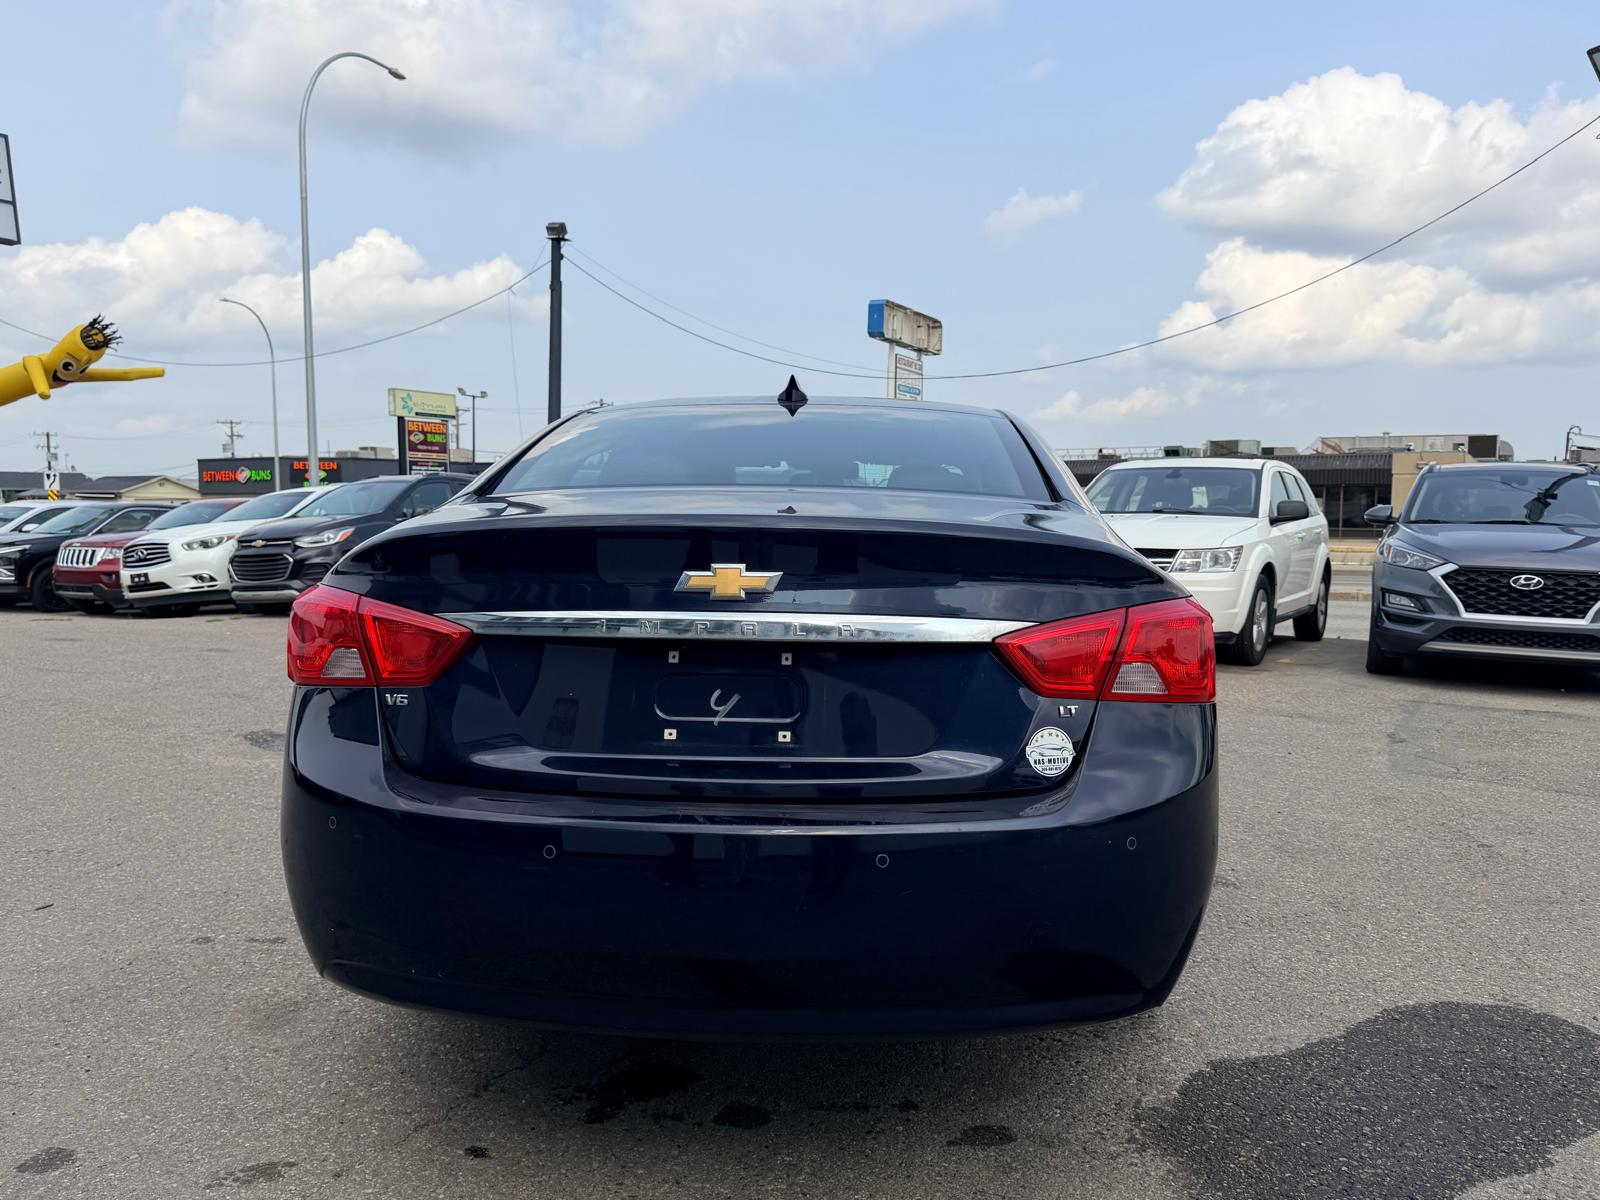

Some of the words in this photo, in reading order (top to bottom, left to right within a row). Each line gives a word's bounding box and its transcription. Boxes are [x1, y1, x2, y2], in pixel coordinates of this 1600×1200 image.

[408, 421, 447, 433] BETWEEN
[427, 433, 446, 443] BUNS
[293, 461, 337, 470] BETEEN
[203, 471, 237, 481] BETWEEN
[251, 469, 272, 481] BUNS
[600, 619, 855, 637] IMPALA
[385, 693, 409, 706] V6
[1059, 705, 1079, 718] LT
